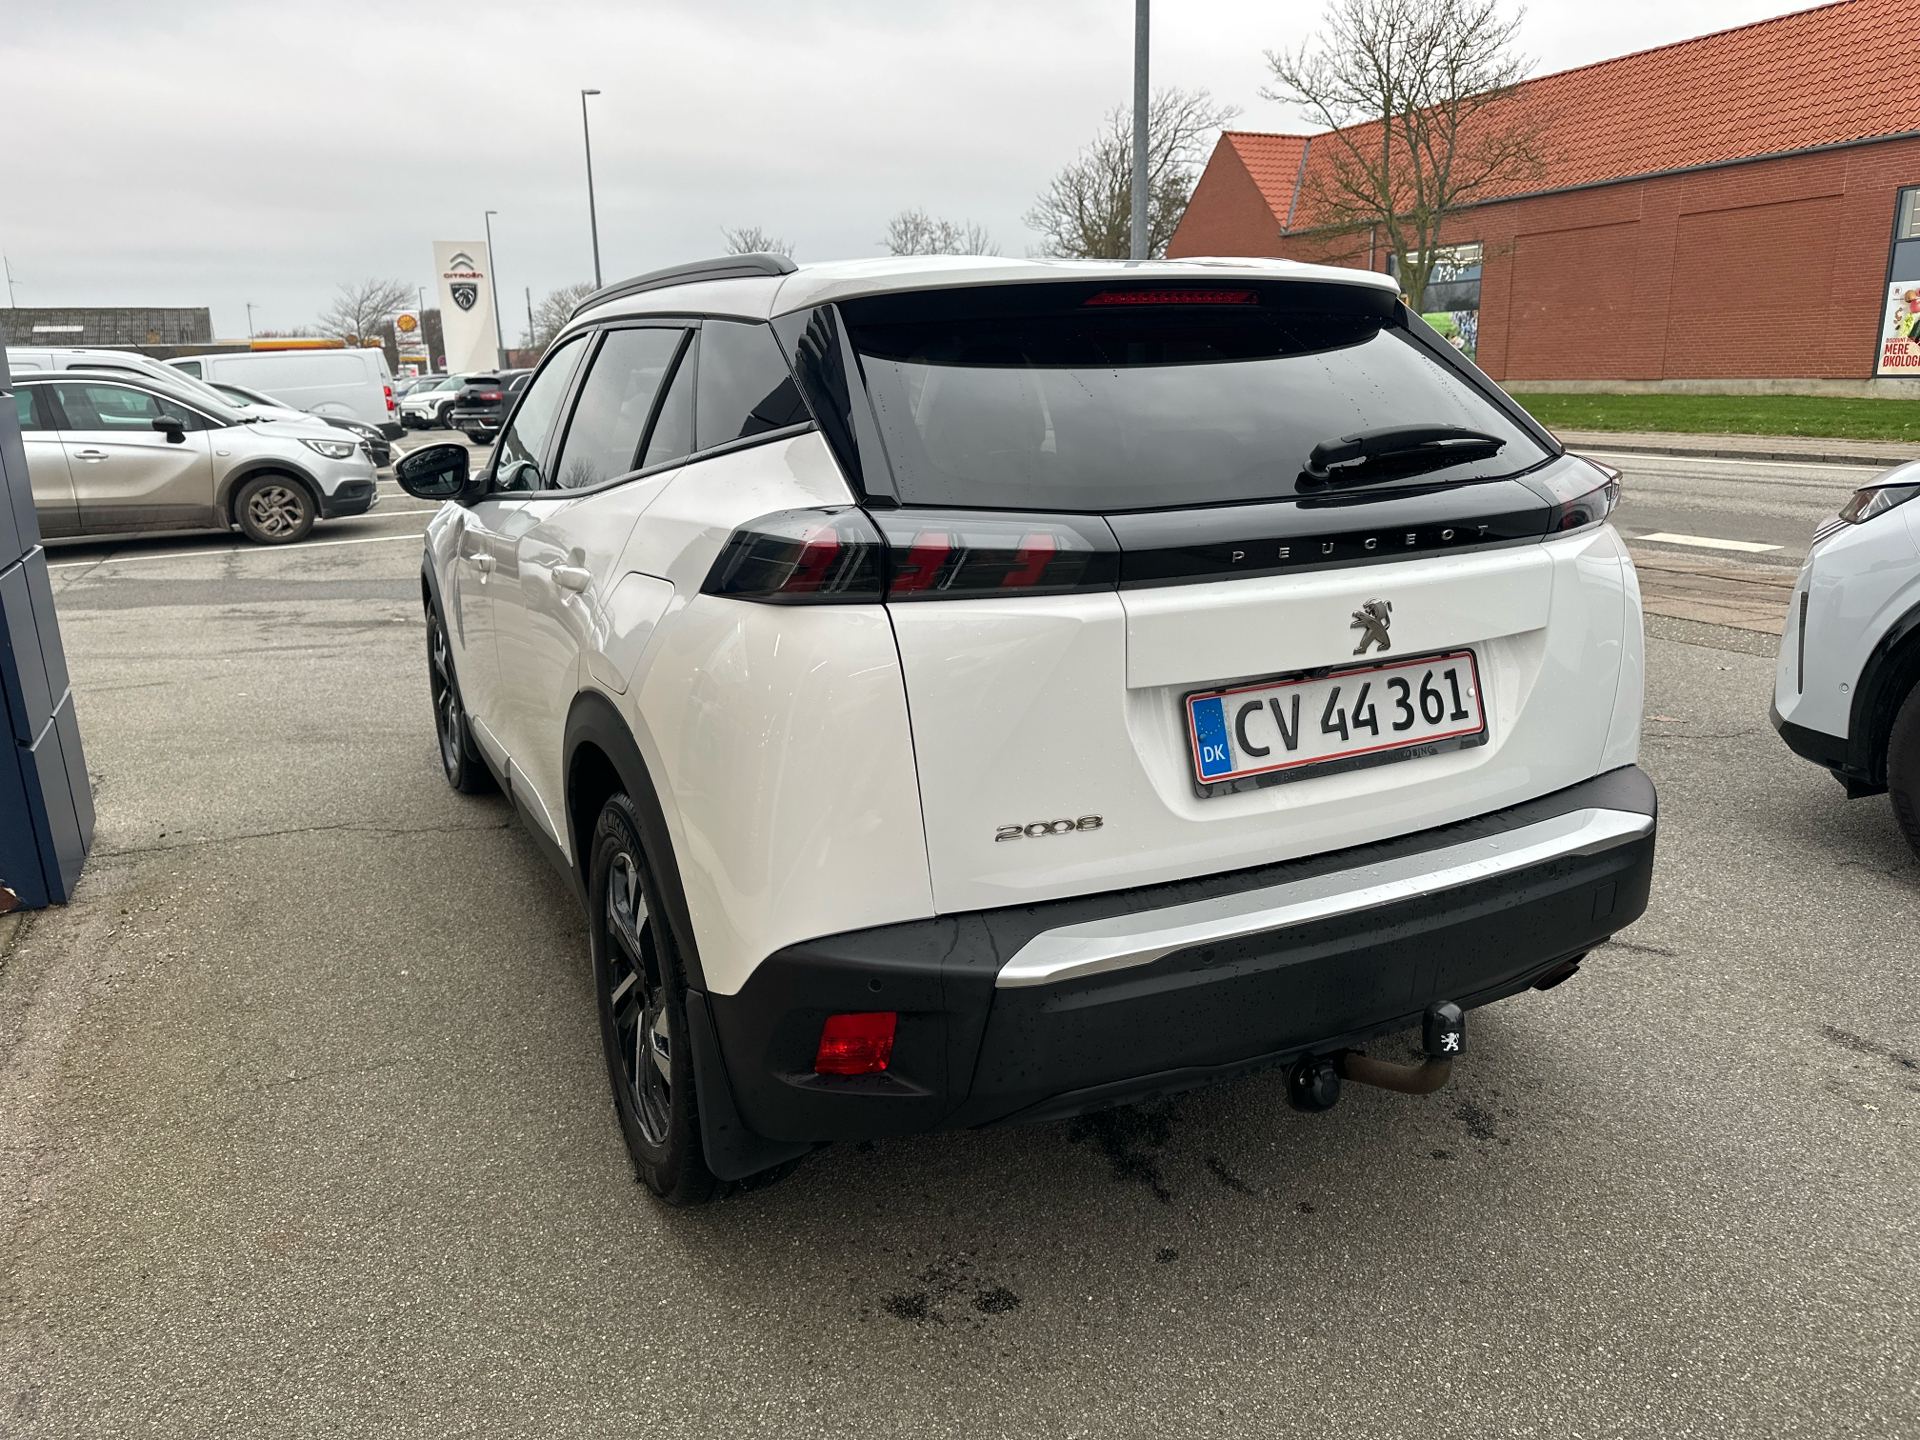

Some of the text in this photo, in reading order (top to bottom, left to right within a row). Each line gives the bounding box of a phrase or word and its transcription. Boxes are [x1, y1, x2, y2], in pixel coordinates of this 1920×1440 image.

[1884, 344, 1909, 355] MERE
[1231, 525, 1488, 563] PEUGEOT
[1234, 693, 1301, 758] CV
[1203, 743, 1227, 764] DK
[994, 814, 1104, 842] 2008
